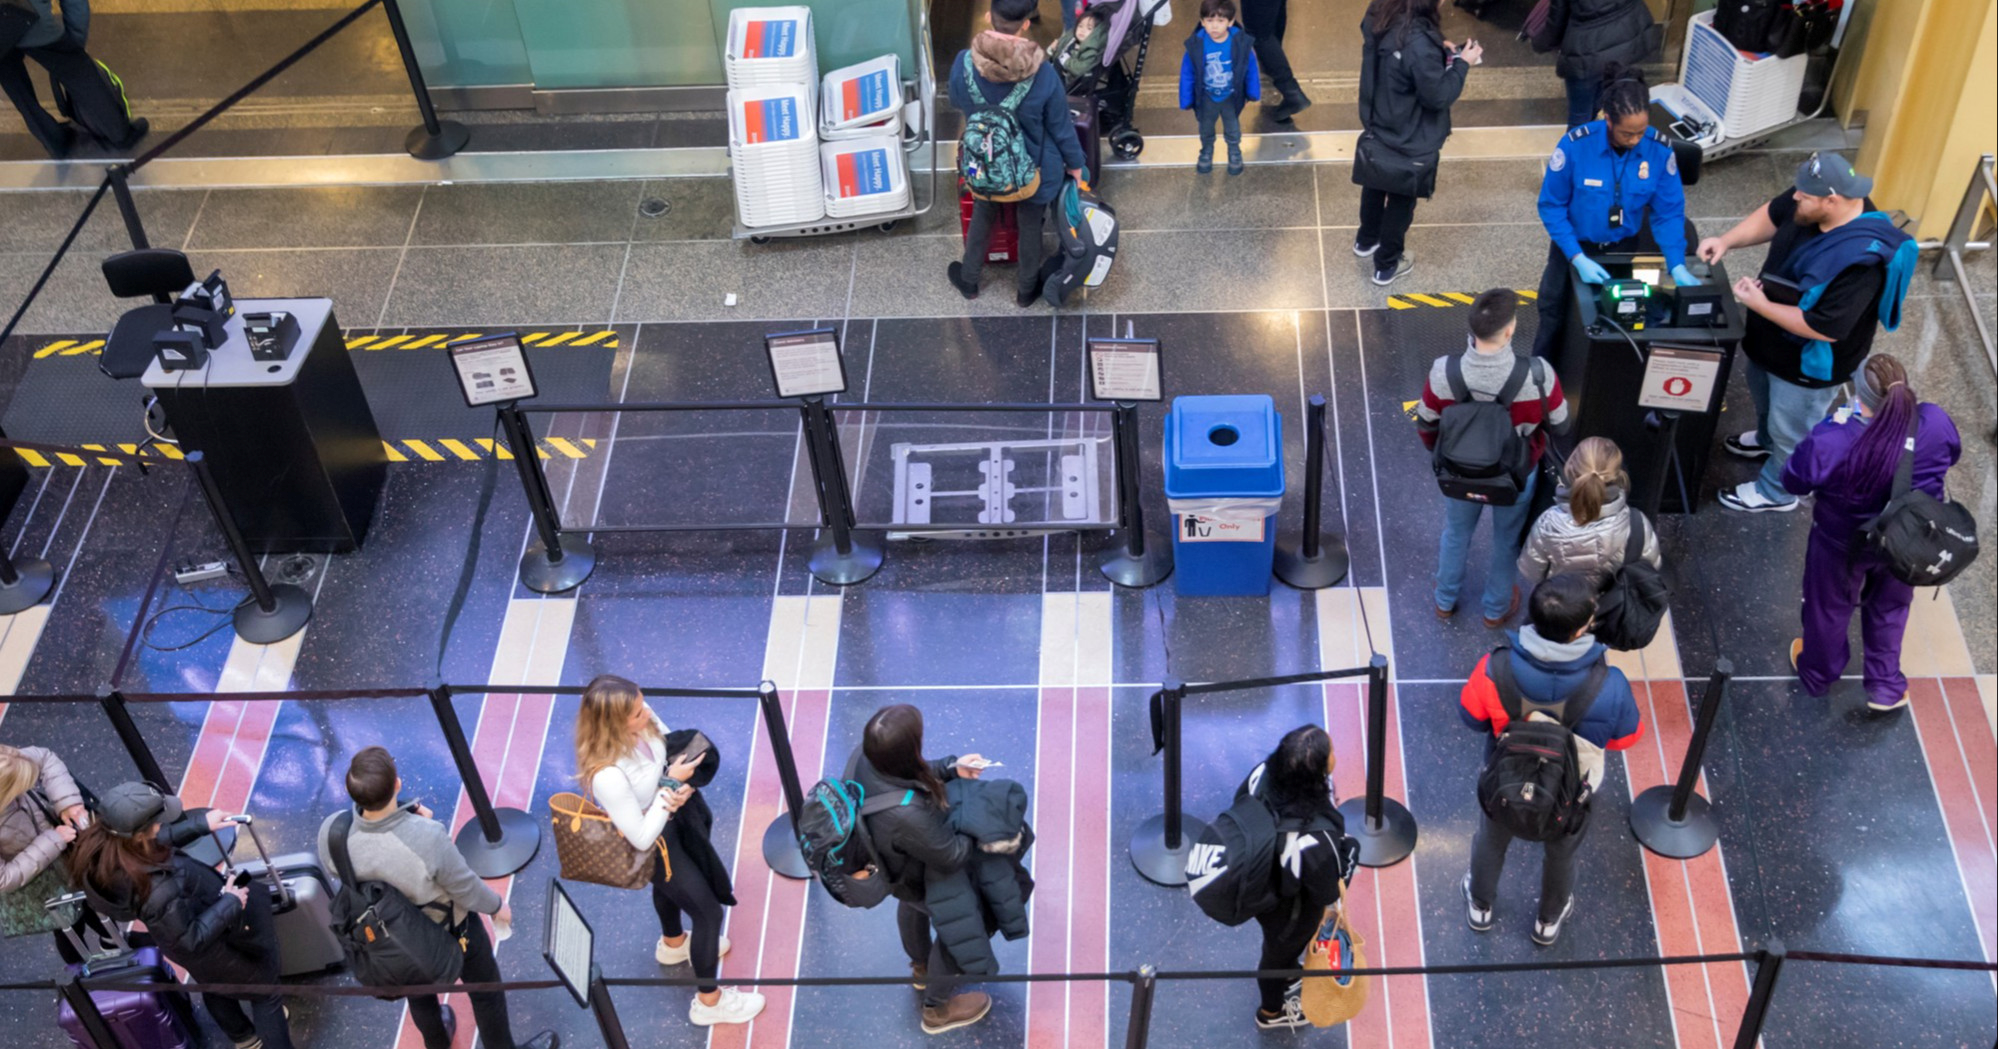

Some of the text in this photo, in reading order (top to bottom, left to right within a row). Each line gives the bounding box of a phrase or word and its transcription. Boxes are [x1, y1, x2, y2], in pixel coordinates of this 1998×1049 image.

[781, 99, 790, 115] Meet
[872, 151, 881, 168] Meet
[1219, 522, 1241, 531] Only
[1184, 842, 1227, 875] NIKE
